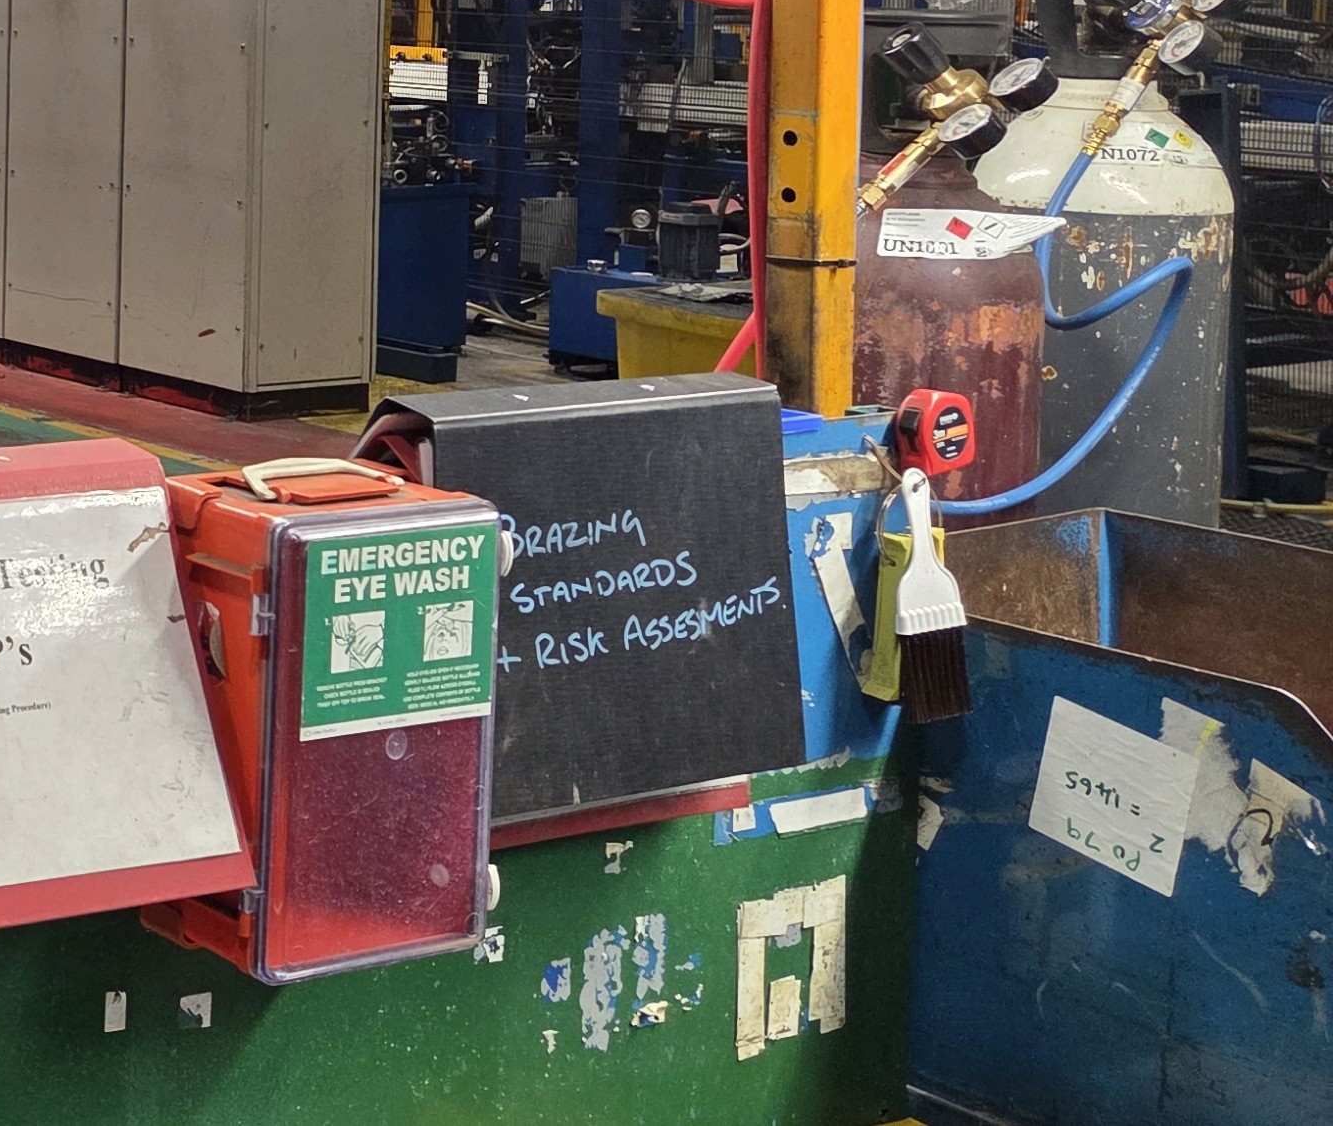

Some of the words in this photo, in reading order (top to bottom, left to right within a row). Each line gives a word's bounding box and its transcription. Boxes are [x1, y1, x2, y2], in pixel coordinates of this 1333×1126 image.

[1098, 147, 1161, 162] N1072
[320, 534, 486, 575] EMERGENCY
[334, 574, 387, 604] EYE
[393, 565, 470, 597] WASH
[510, 550, 697, 613] STANDARDS
[535, 626, 609, 669] RISK
